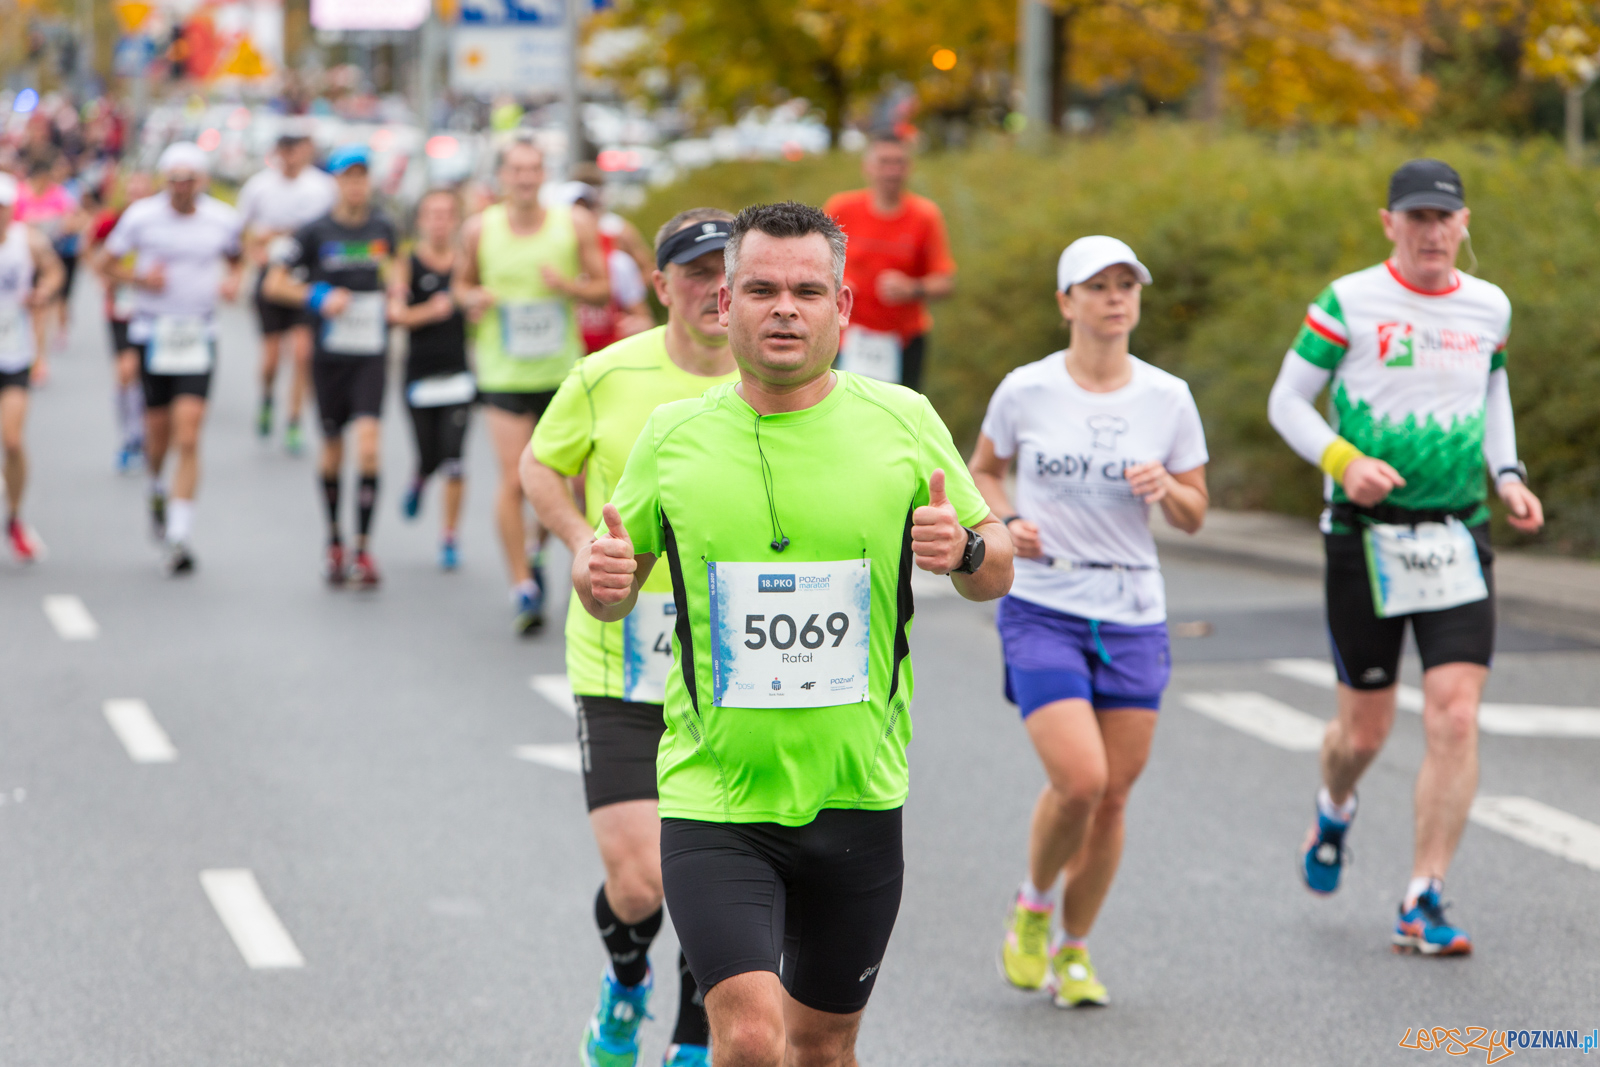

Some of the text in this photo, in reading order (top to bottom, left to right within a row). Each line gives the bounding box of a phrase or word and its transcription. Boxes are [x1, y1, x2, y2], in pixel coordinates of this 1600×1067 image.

[761, 579, 793, 588] 18. PKO
[798, 582, 830, 590] maraton
[743, 611, 850, 650] 5069
[782, 652, 813, 663] Rafał
[800, 681, 816, 690] 4F
